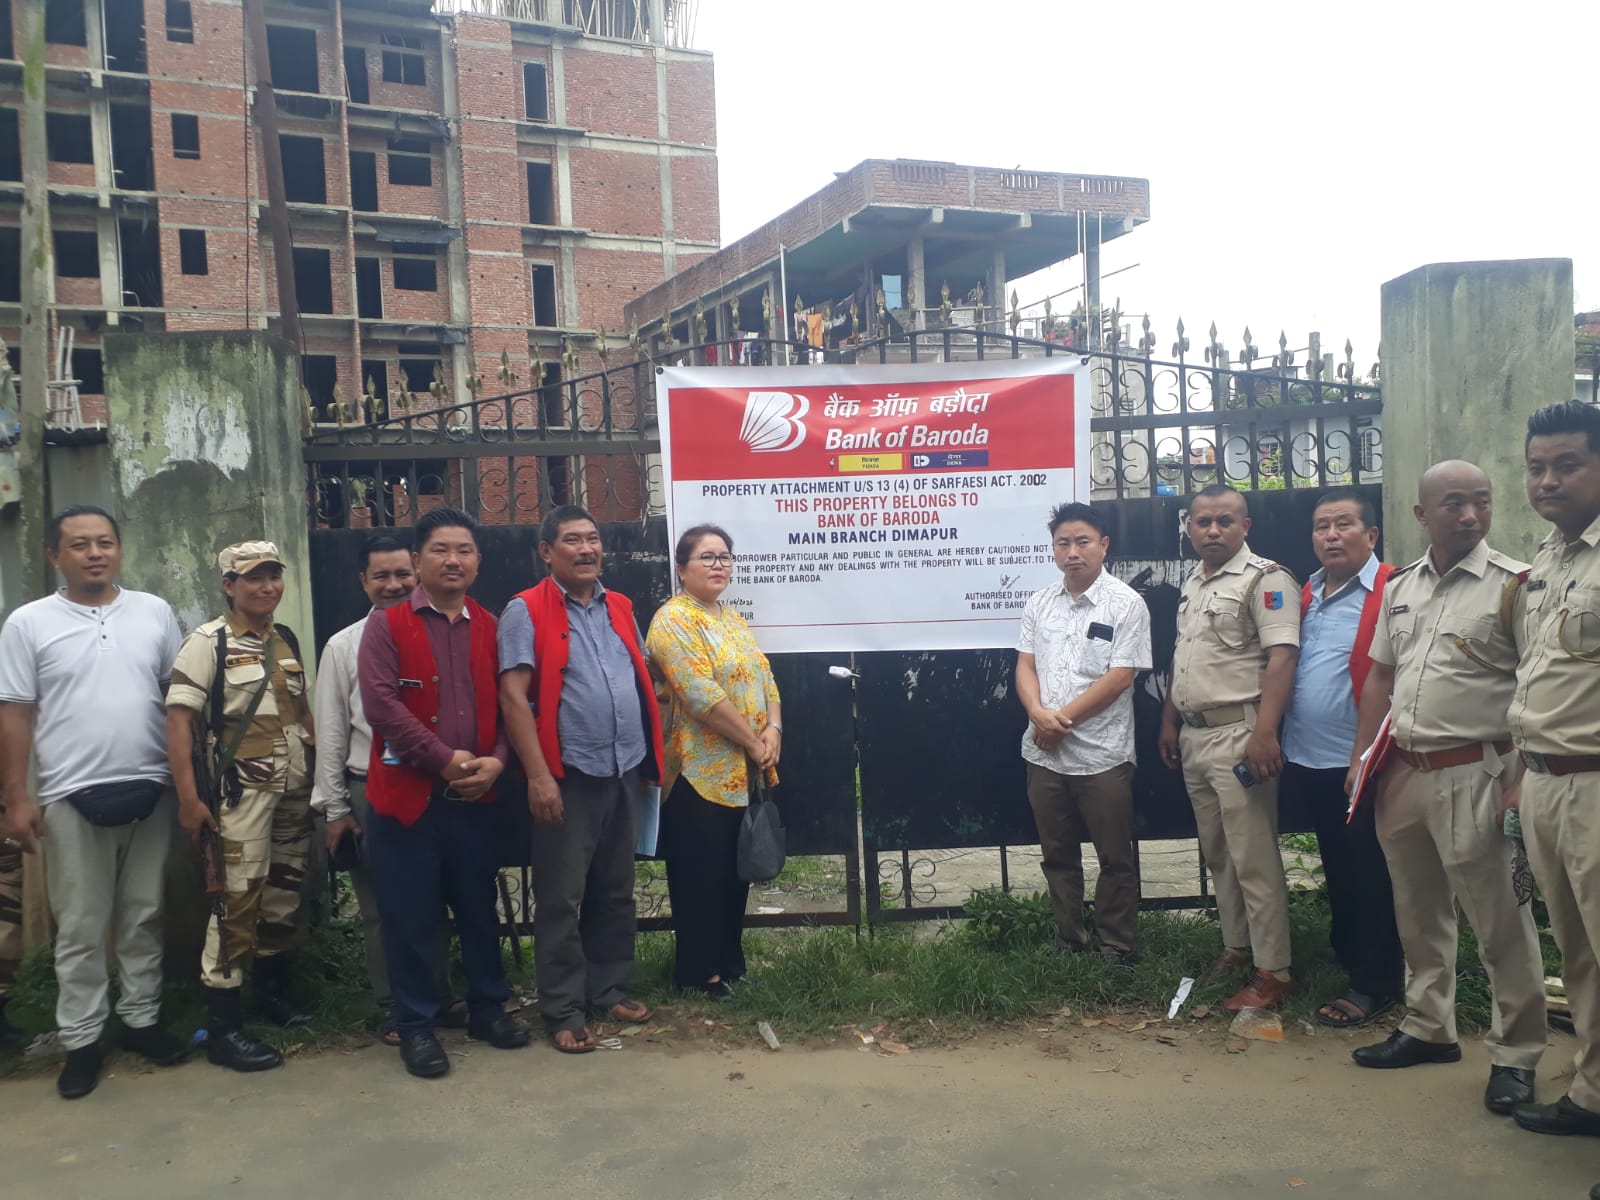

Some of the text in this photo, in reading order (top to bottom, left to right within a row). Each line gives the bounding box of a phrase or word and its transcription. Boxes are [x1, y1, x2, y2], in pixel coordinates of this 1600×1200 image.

[823, 391, 861, 419] बैंक
[929, 387, 992, 417] बड़ौदा
[825, 422, 990, 451] Bank of Baroda
[702, 473, 1047, 497] PROPERTY ATTACHMENT U/S 13 (4) OF SARFAESI ACT. 2002
[775, 492, 978, 513] THIS PROPERTY BELONGS TO
[817, 510, 940, 529] BANK OF BARODA
[788, 527, 959, 545] MAIN BRANCH DIMAPUR
[780, 552, 829, 562] PARTICULAR
[833, 551, 849, 560] AND
[853, 550, 881, 559] PUBLIC
[885, 550, 894, 558] IN
[898, 549, 934, 558] GENERAL
[937, 548, 952, 557] ARE
[956, 546, 985, 556] HEREBY
[988, 545, 1031, 555] CAUTIONED
[1033, 544, 1049, 553] NOT
[736, 565, 751, 574] THE
[755, 564, 796, 573] PROPERTY
[799, 563, 815, 572] AND
[819, 562, 835, 571] ANY
[838, 561, 876, 571] DEALINGS
[880, 560, 900, 569] WITH
[904, 559, 918, 568] THE
[921, 558, 962, 568] PROPERTY
[965, 557, 984, 567] WILL
[987, 556, 997, 566] BE
[736, 576, 751, 585] THE
[754, 575, 775, 584] BANK
[777, 575, 786, 584] OF
[789, 574, 823, 583] BARODA.
[964, 591, 1013, 601] AUTHORISED
[971, 602, 992, 610] BANK
[994, 601, 1003, 610] OF
